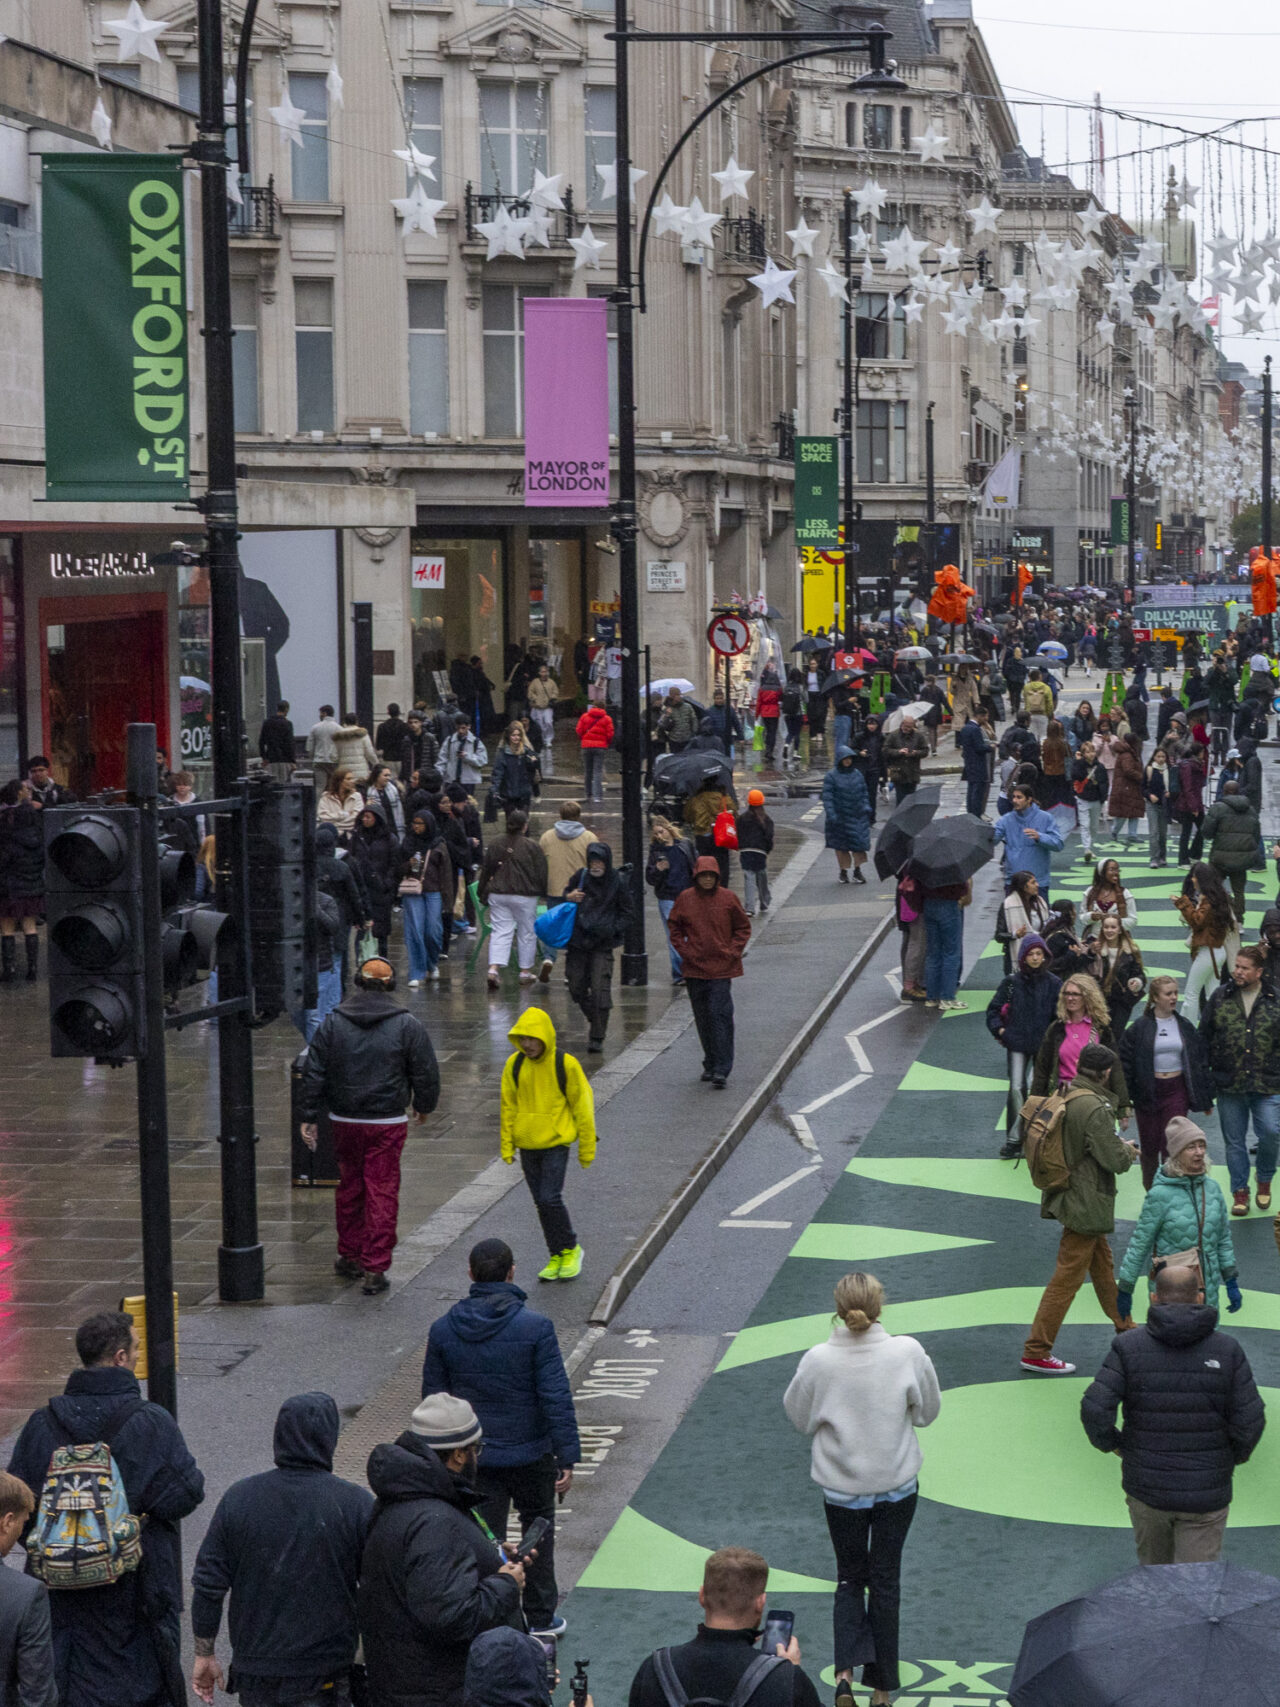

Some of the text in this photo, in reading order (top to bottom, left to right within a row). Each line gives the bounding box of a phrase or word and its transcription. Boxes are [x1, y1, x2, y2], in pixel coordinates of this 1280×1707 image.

[128, 179, 184, 435] OXFORD
[801, 443, 832, 452] MORE
[801, 452, 832, 463] SPACE
[528, 461, 606, 476] MAYOR OF
[528, 476, 606, 491] LONDON
[805, 519, 829, 529] LESS
[796, 528, 838, 539] TRAFFIC
[414, 562, 443, 583] H&M
[1144, 609, 1216, 621] DILLY-DALLY
[572, 1359, 665, 1401] LOOK
